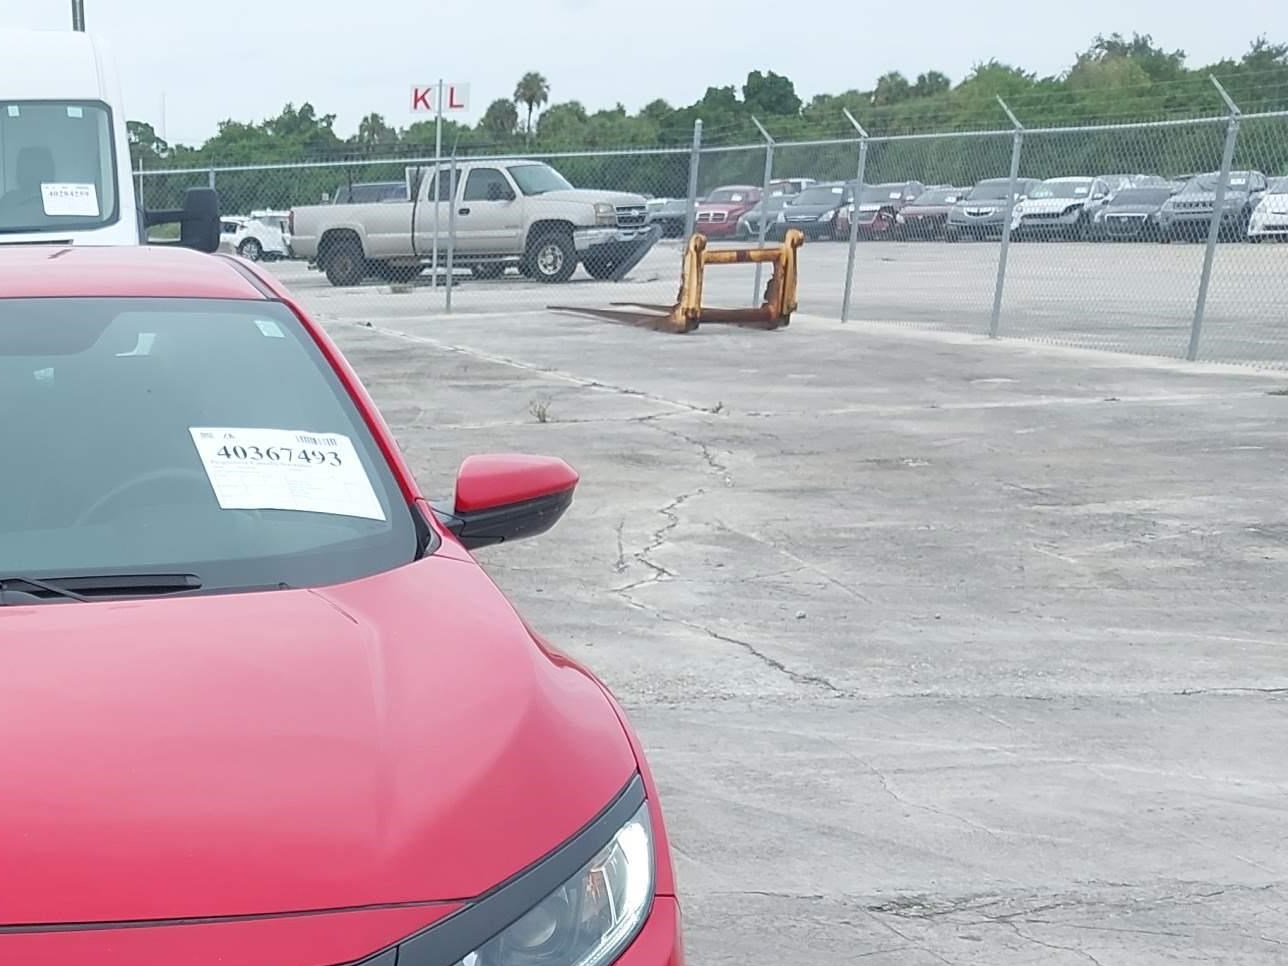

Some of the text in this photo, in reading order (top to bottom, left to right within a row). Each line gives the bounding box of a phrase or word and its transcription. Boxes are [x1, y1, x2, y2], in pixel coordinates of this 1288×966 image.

[413, 87, 432, 110] K
[449, 86, 464, 109] L
[216, 445, 342, 467] 40367493
